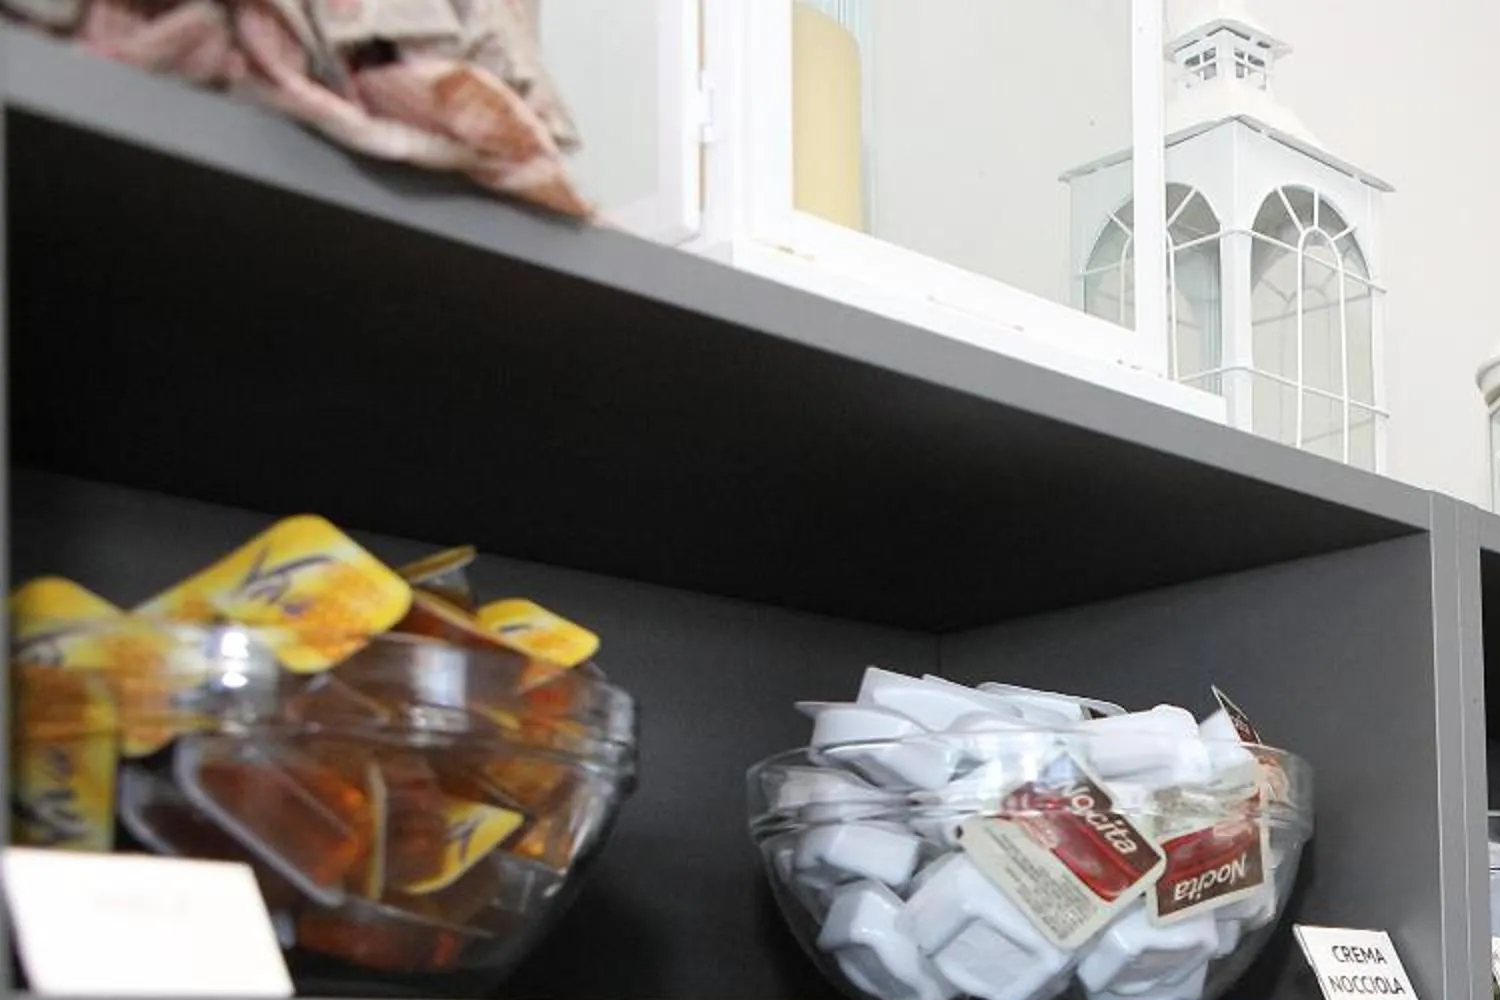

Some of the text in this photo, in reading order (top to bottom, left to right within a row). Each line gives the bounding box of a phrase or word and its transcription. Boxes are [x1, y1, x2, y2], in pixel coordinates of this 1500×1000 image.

[1173, 853, 1248, 901] Nocita
[1331, 945, 1388, 964] CREMA
[1327, 975, 1406, 995] NOCCIOLA
